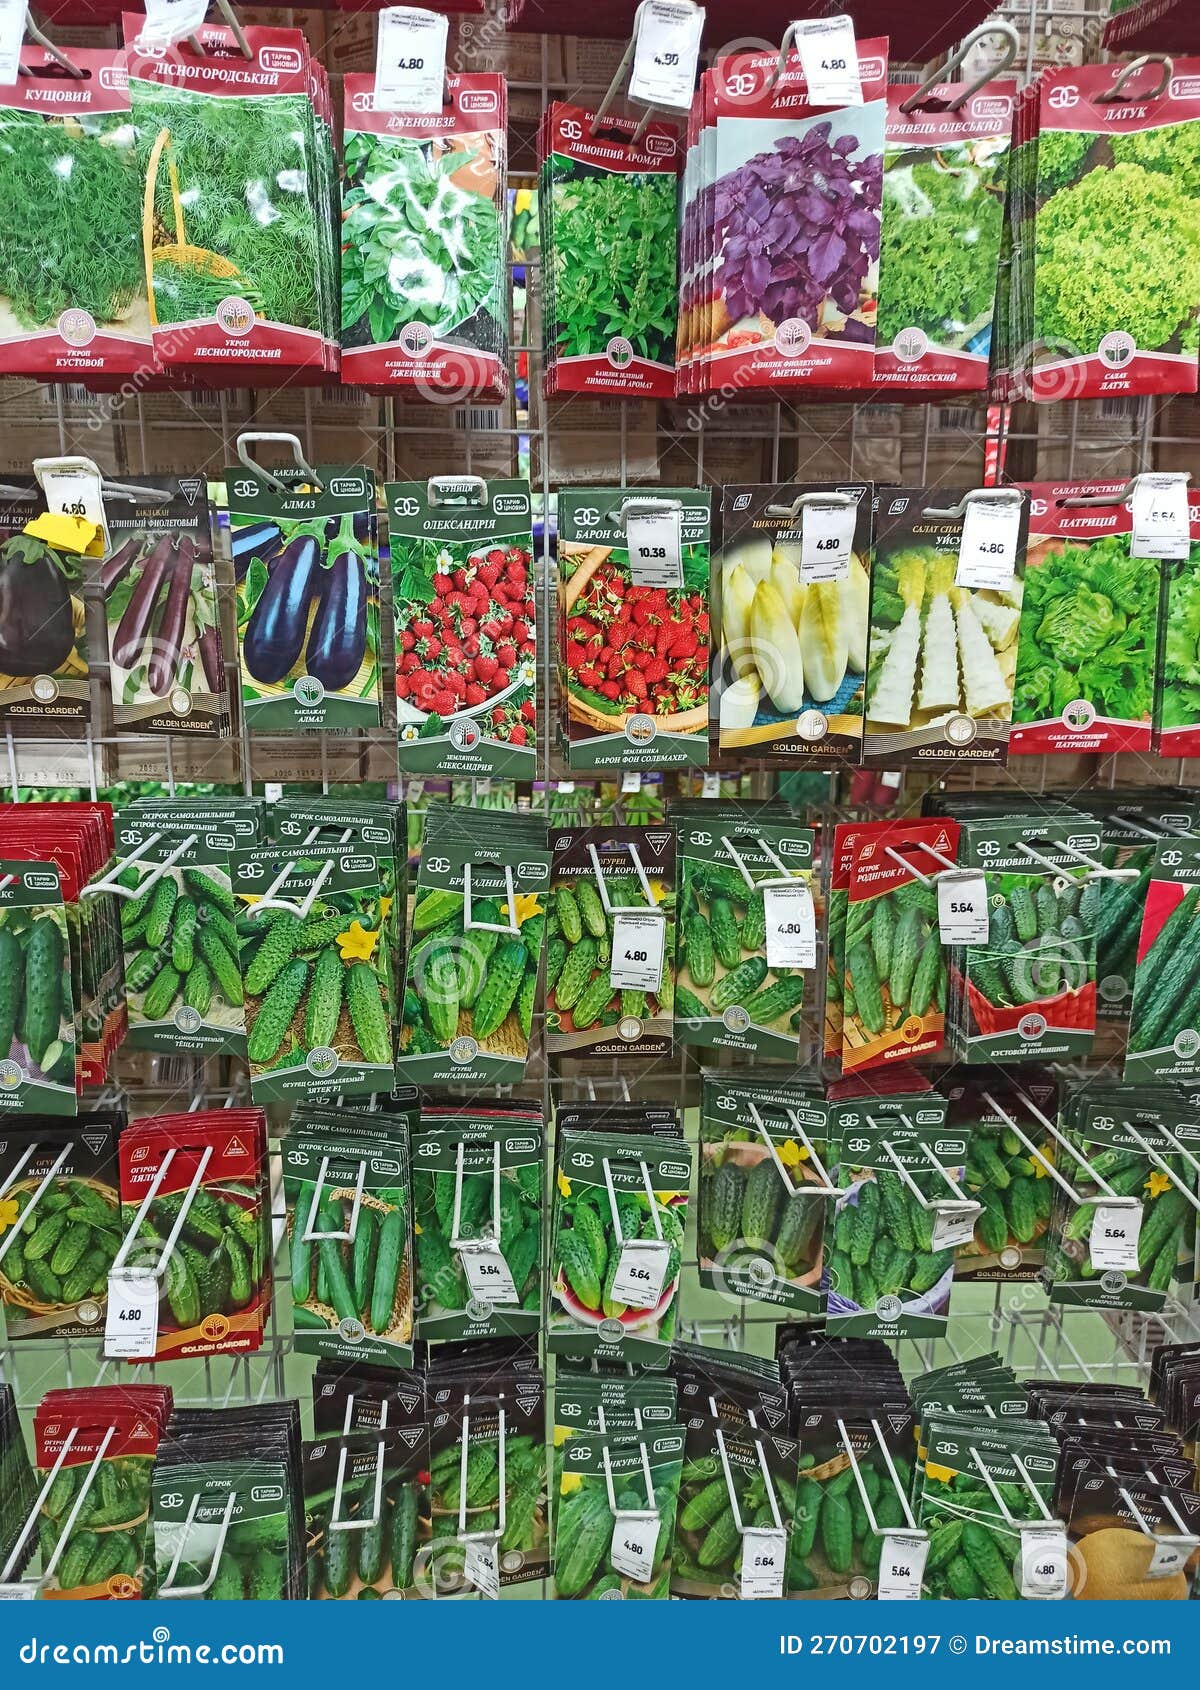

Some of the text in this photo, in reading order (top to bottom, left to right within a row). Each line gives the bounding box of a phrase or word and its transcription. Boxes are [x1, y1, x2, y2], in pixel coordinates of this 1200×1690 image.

[263, 54, 269, 66] 1
[398, 58, 424, 69] 4.80
[821, 59, 846, 69] 4.80
[154, 62, 279, 86] ЛІСНОГОРОДСЬКИЙ
[25, 89, 91, 103] КУЩОВИЙ
[772, 94, 808, 108] АМЕТ
[463, 96, 468, 107] 1
[976, 102, 981, 113] 1
[1104, 107, 1148, 120] ЛАТУК
[387, 116, 456, 129] ДЖЕНОВЕЗЕ
[939, 120, 1001, 132] ОДЕСЬКИЙ
[569, 142, 663, 166] ЛИМОННИЙ АРОМАТ
[225, 339, 250, 347] УКРОП
[67, 349, 91, 357] УКРОП
[194, 347, 281, 358] ЛЕСНОГОРОДСКИЙ
[56, 358, 104, 368] КУСТОВОЙ
[390, 369, 441, 378] ДЖЕНОВЕЗЕ
[770, 368, 812, 378] АМЕТИСТ
[910, 373, 957, 382] ОДЕССКИЙ
[627, 380, 653, 389] АРОМАТ
[1099, 381, 1130, 390] ЛАТУК
[333, 483, 338, 492] 1
[1052, 487, 1080, 495] САЛАТ
[62, 503, 86, 515] 4.80
[281, 500, 315, 509] АЛМАЗ
[497, 500, 502, 509] 3
[148, 518, 198, 528] ФИОЛЕТОВЫЙ
[423, 519, 496, 531] ОЛЕКСАНДРІЯ
[752, 520, 794, 528] ЦИКОРИЙ
[1059, 516, 1118, 528] ПАТРИЦІЙ
[575, 529, 609, 539] БАРОН
[912, 525, 938, 534] САЛАТ
[816, 539, 839, 550] 4.80
[980, 543, 1004, 553] 4.80
[638, 547, 665, 558] 10.38
[10, 705, 43, 714] GOLDEN
[152, 719, 180, 728] GOLDEN
[773, 743, 808, 753] GOLDEN
[1055, 740, 1100, 749] ПАТРИЦИЙ
[595, 756, 620, 764] БАРОН
[640, 753, 687, 763] СОЛЕМАХЕР
[918, 749, 956, 758] GOLDEN
[437, 761, 493, 771] АЛЕКСАНДРИЯ
[290, 813, 374, 825] ОГІРОК САМОЗАПИЛЬНИЙ
[157, 822, 217, 832] САМОЗАПИЛЬНИЙ
[735, 826, 761, 835] ОГІРОК
[208, 837, 214, 845] 4
[1070, 840, 1075, 848] 2
[251, 846, 354, 860] ОГІРОК САМОЗАПИЛЬНИЙ
[474, 850, 501, 859] ОГІРОК
[344, 860, 349, 869] 4
[983, 857, 1032, 868] КУЩОВИЙ
[519, 865, 525, 874] 2
[559, 867, 613, 875] ПАРИЖСИЙ
[858, 865, 879, 873] ОГІРОК
[856, 868, 906, 883] РОДНІЧОК F1
[951, 903, 973, 913] 5.64
[778, 924, 800, 934] 4.80
[625, 951, 647, 961] 4.80
[595, 1044, 626, 1052] GOLDEN
[323, 1146, 383, 1156] САМОЗАПИЛЬНИЙ
[617, 1148, 643, 1157] ОГІРОК
[1105, 1228, 1125, 1239] 5.64
[480, 1265, 500, 1275] 5.64
[629, 1268, 650, 1280] 5.64
[119, 1310, 141, 1320] 4.80
[181, 1340, 250, 1353] GOLDEN GARDEN
[614, 1435, 638, 1443] ОГІРОК
[623, 1540, 643, 1554] 4.80
[755, 1557, 774, 1566] 5.64
[892, 1566, 910, 1576] 5.64
[1035, 1566, 1054, 1575] 4.80
